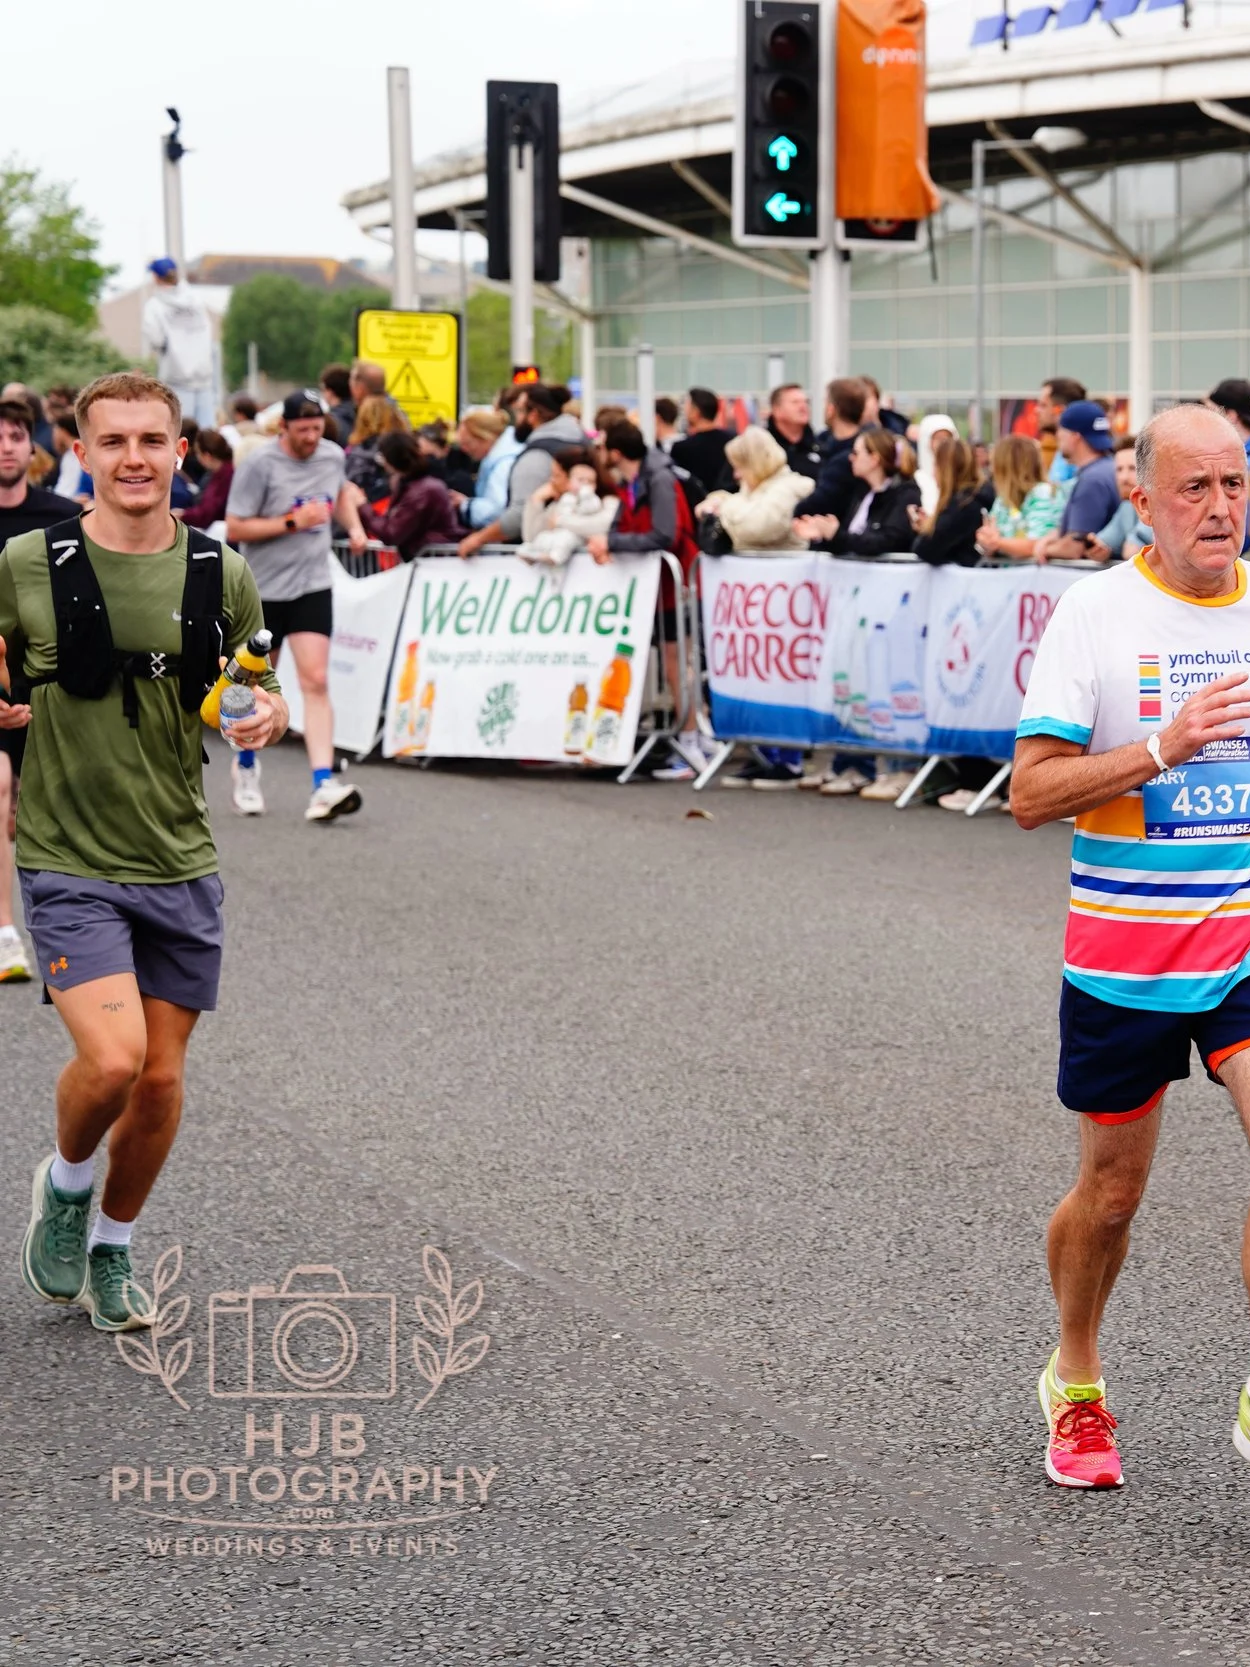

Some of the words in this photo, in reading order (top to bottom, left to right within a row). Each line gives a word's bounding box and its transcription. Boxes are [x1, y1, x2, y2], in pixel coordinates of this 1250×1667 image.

[421, 575, 510, 635] Well
[510, 575, 637, 636] done!
[1168, 650, 1242, 668] ymchwil
[1205, 739, 1249, 750] SWANSEA
